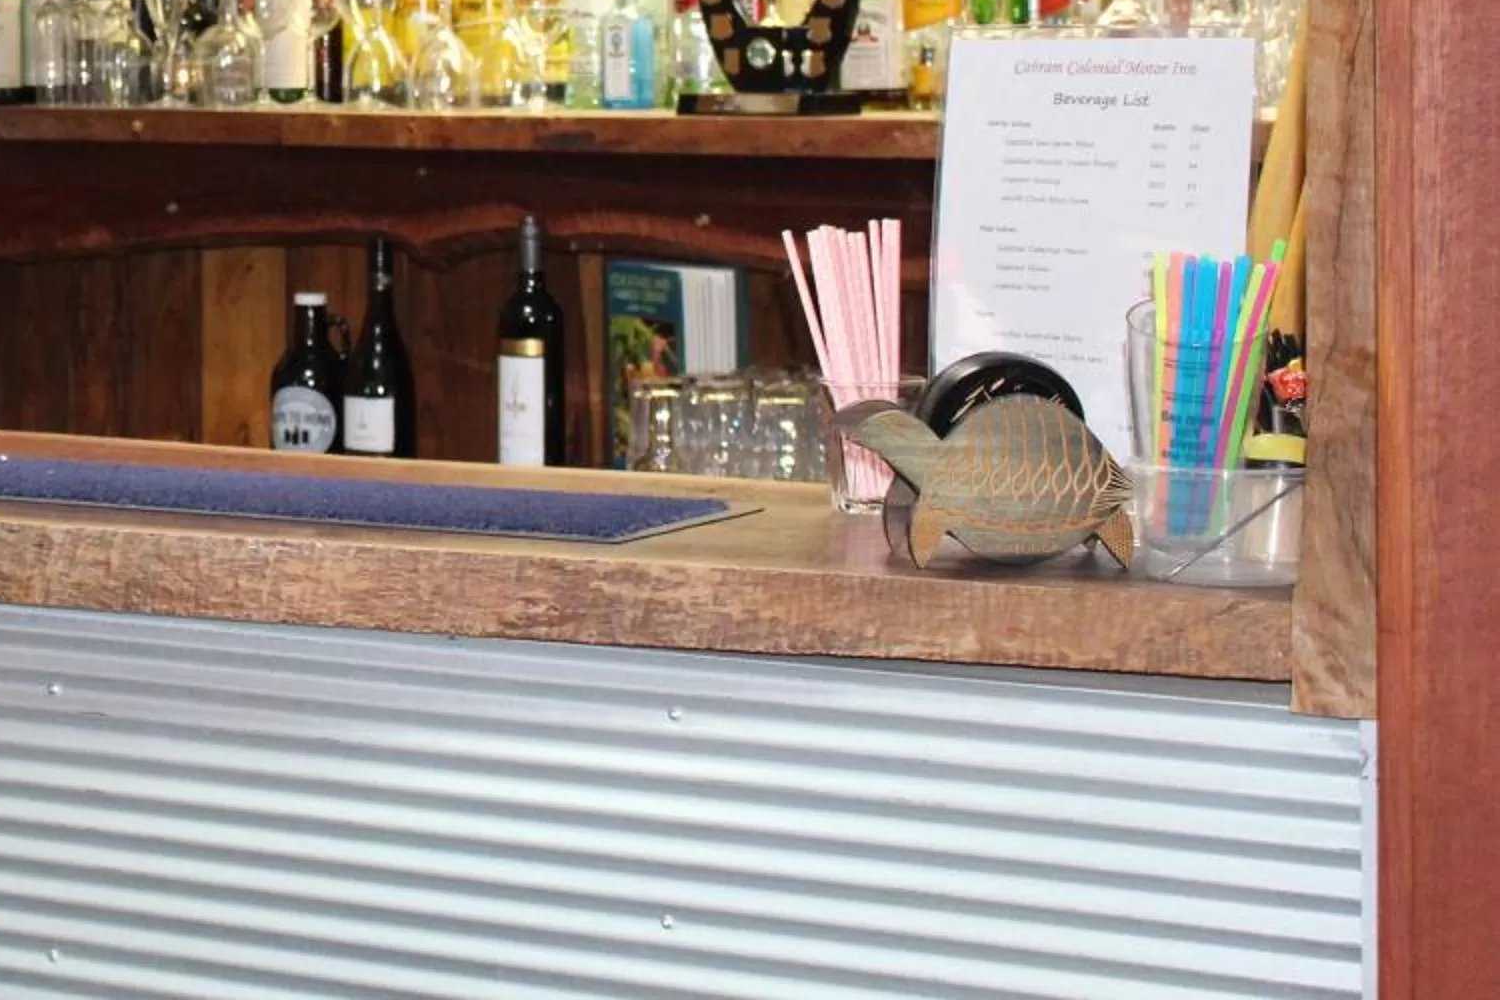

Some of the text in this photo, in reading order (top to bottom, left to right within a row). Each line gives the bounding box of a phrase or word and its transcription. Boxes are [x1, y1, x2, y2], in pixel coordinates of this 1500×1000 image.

[1124, 60, 1168, 75] Motor
[1053, 92, 1150, 111] Beverage List
